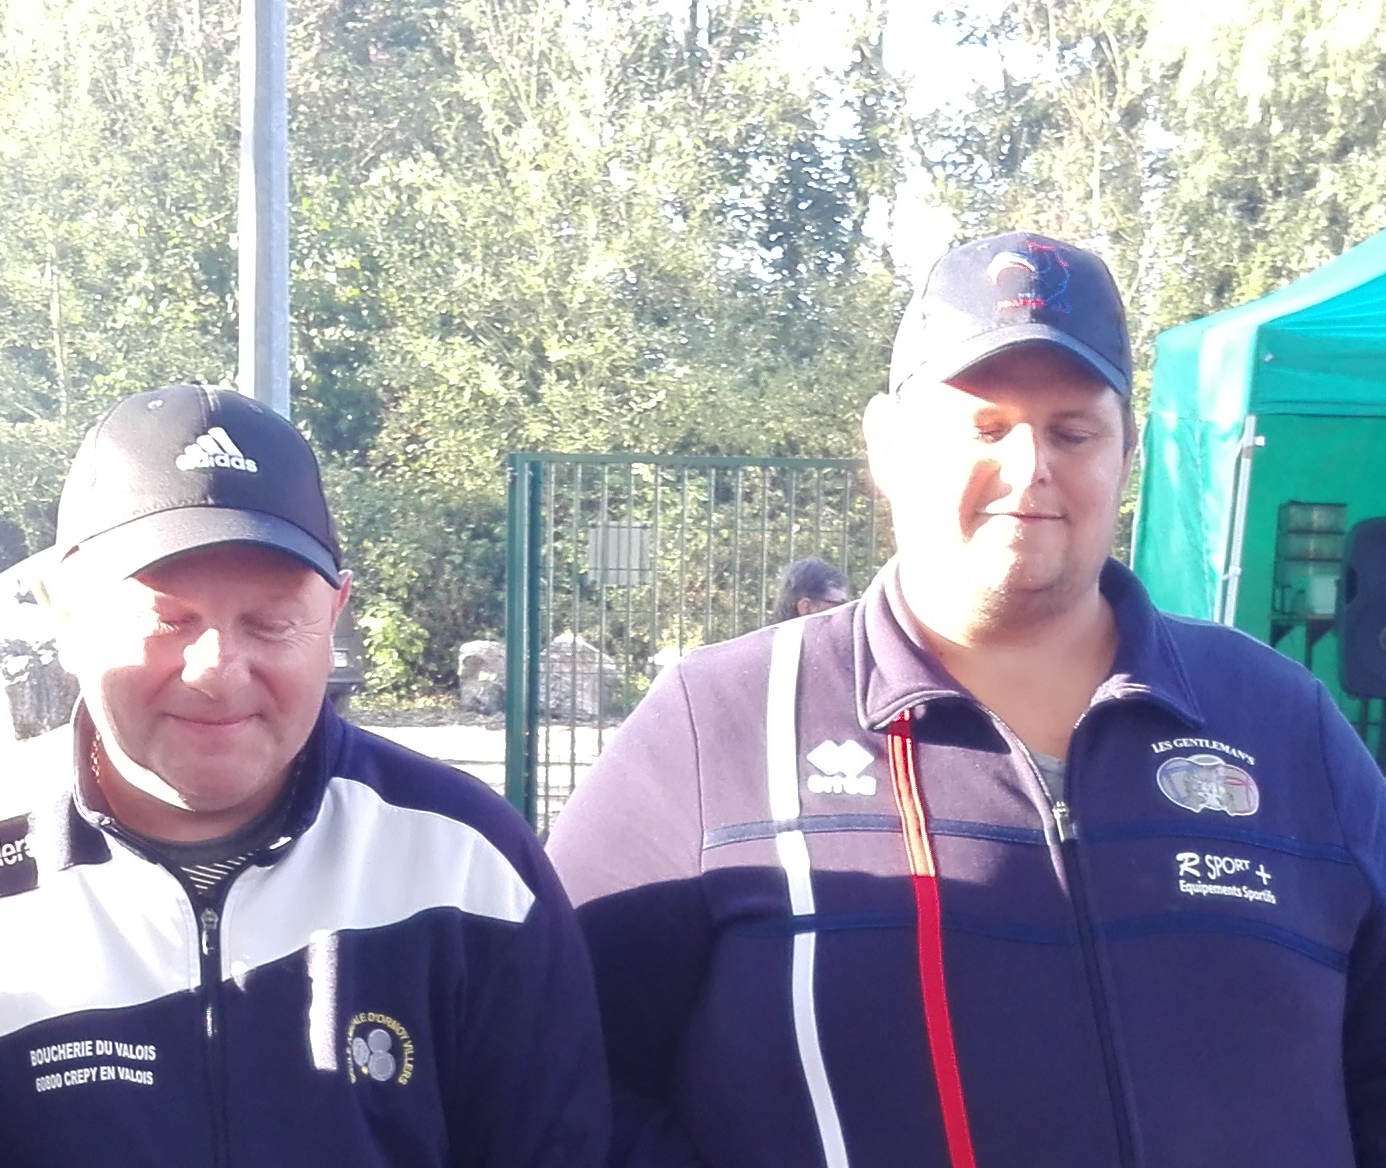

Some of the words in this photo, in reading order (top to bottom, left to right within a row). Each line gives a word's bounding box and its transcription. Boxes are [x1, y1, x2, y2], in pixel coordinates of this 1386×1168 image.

[176, 453, 258, 473] didas
[1151, 740, 1173, 754] LES
[1173, 738, 1255, 765] GENTLEMAN'S
[1176, 852, 1201, 877] R
[1205, 854, 1250, 880] SPORT
[1179, 880, 1242, 897] Equipements
[29, 1040, 93, 1067] BOUCHERIE
[95, 1040, 113, 1055] DU
[114, 1041, 156, 1061] VALOIS
[63, 1067, 98, 1086] CREPY
[99, 1066, 115, 1081] EN
[117, 1066, 154, 1085] VALOIS
